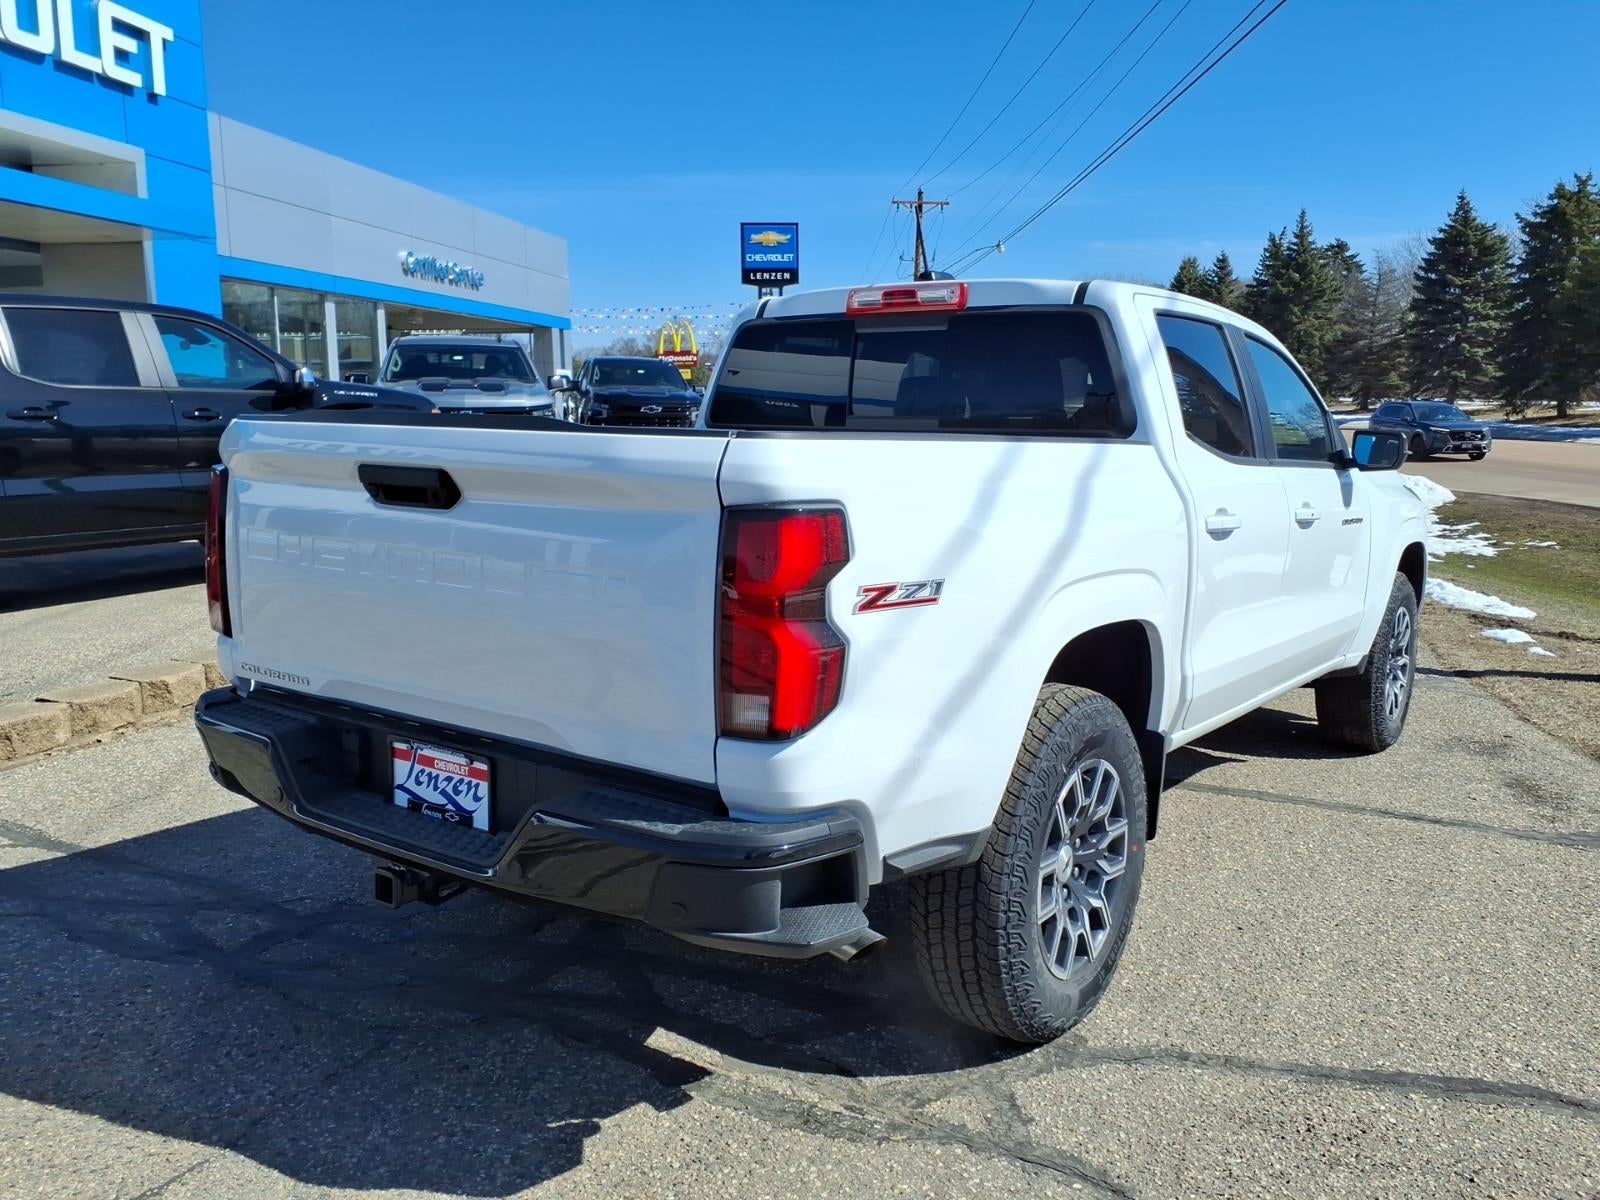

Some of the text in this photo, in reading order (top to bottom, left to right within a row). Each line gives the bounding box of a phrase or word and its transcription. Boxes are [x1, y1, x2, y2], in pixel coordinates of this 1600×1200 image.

[0, 0, 174, 97] OLET
[402, 250, 484, 288] Certified Service
[746, 253, 794, 262] CHEVROLET
[750, 272, 790, 280] LENZEN
[851, 578, 945, 615] Z71
[240, 662, 310, 687] COLORADO
[393, 745, 486, 816] Lenzen
[434, 759, 469, 776] CHEVROLET
